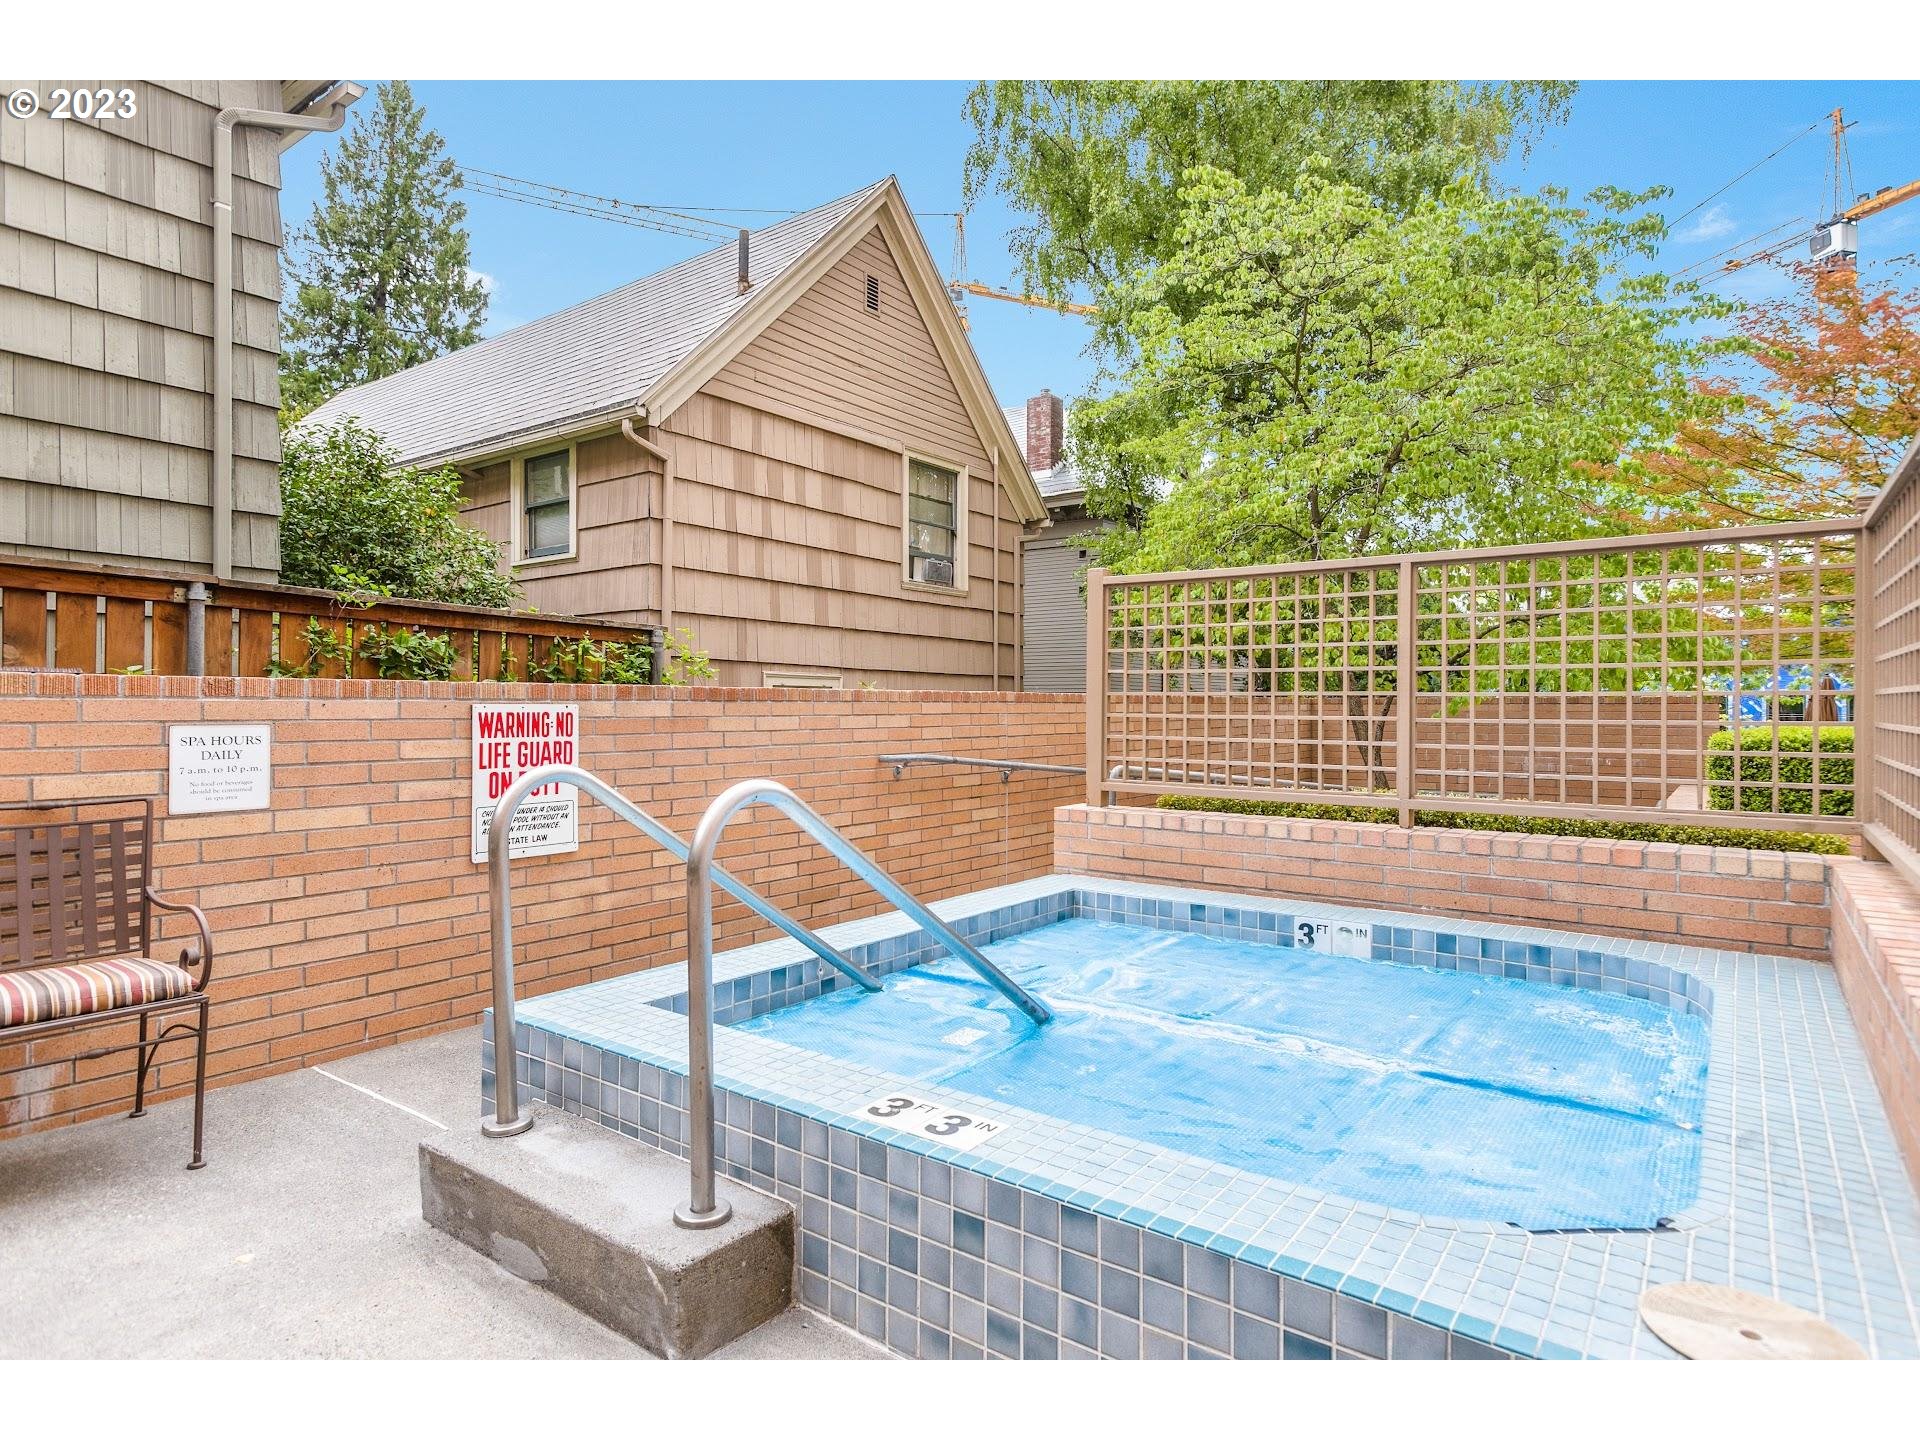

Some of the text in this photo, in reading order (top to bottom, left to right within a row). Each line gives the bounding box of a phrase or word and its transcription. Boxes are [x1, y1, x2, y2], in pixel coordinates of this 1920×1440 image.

[556, 712, 574, 737] NO
[180, 735, 262, 747] SPA HOURS
[201, 749, 243, 760] DAILY
[479, 741, 573, 770] LIFE GUARD
[179, 767, 185, 775] 7
[187, 767, 210, 775] a.m.
[227, 765, 238, 773] 10
[240, 765, 262, 774] p.m.
[516, 806, 538, 814] UNDER
[546, 804, 569, 813] SHOULD
[513, 815, 529, 823] POOL
[531, 812, 560, 822] WITHOUT
[532, 834, 548, 843] LAW
[1297, 922, 1315, 949] 3
[1316, 924, 1329, 935] FT
[1355, 928, 1368, 938] IN
[867, 1097, 999, 1136] 3 FT 3 IN
